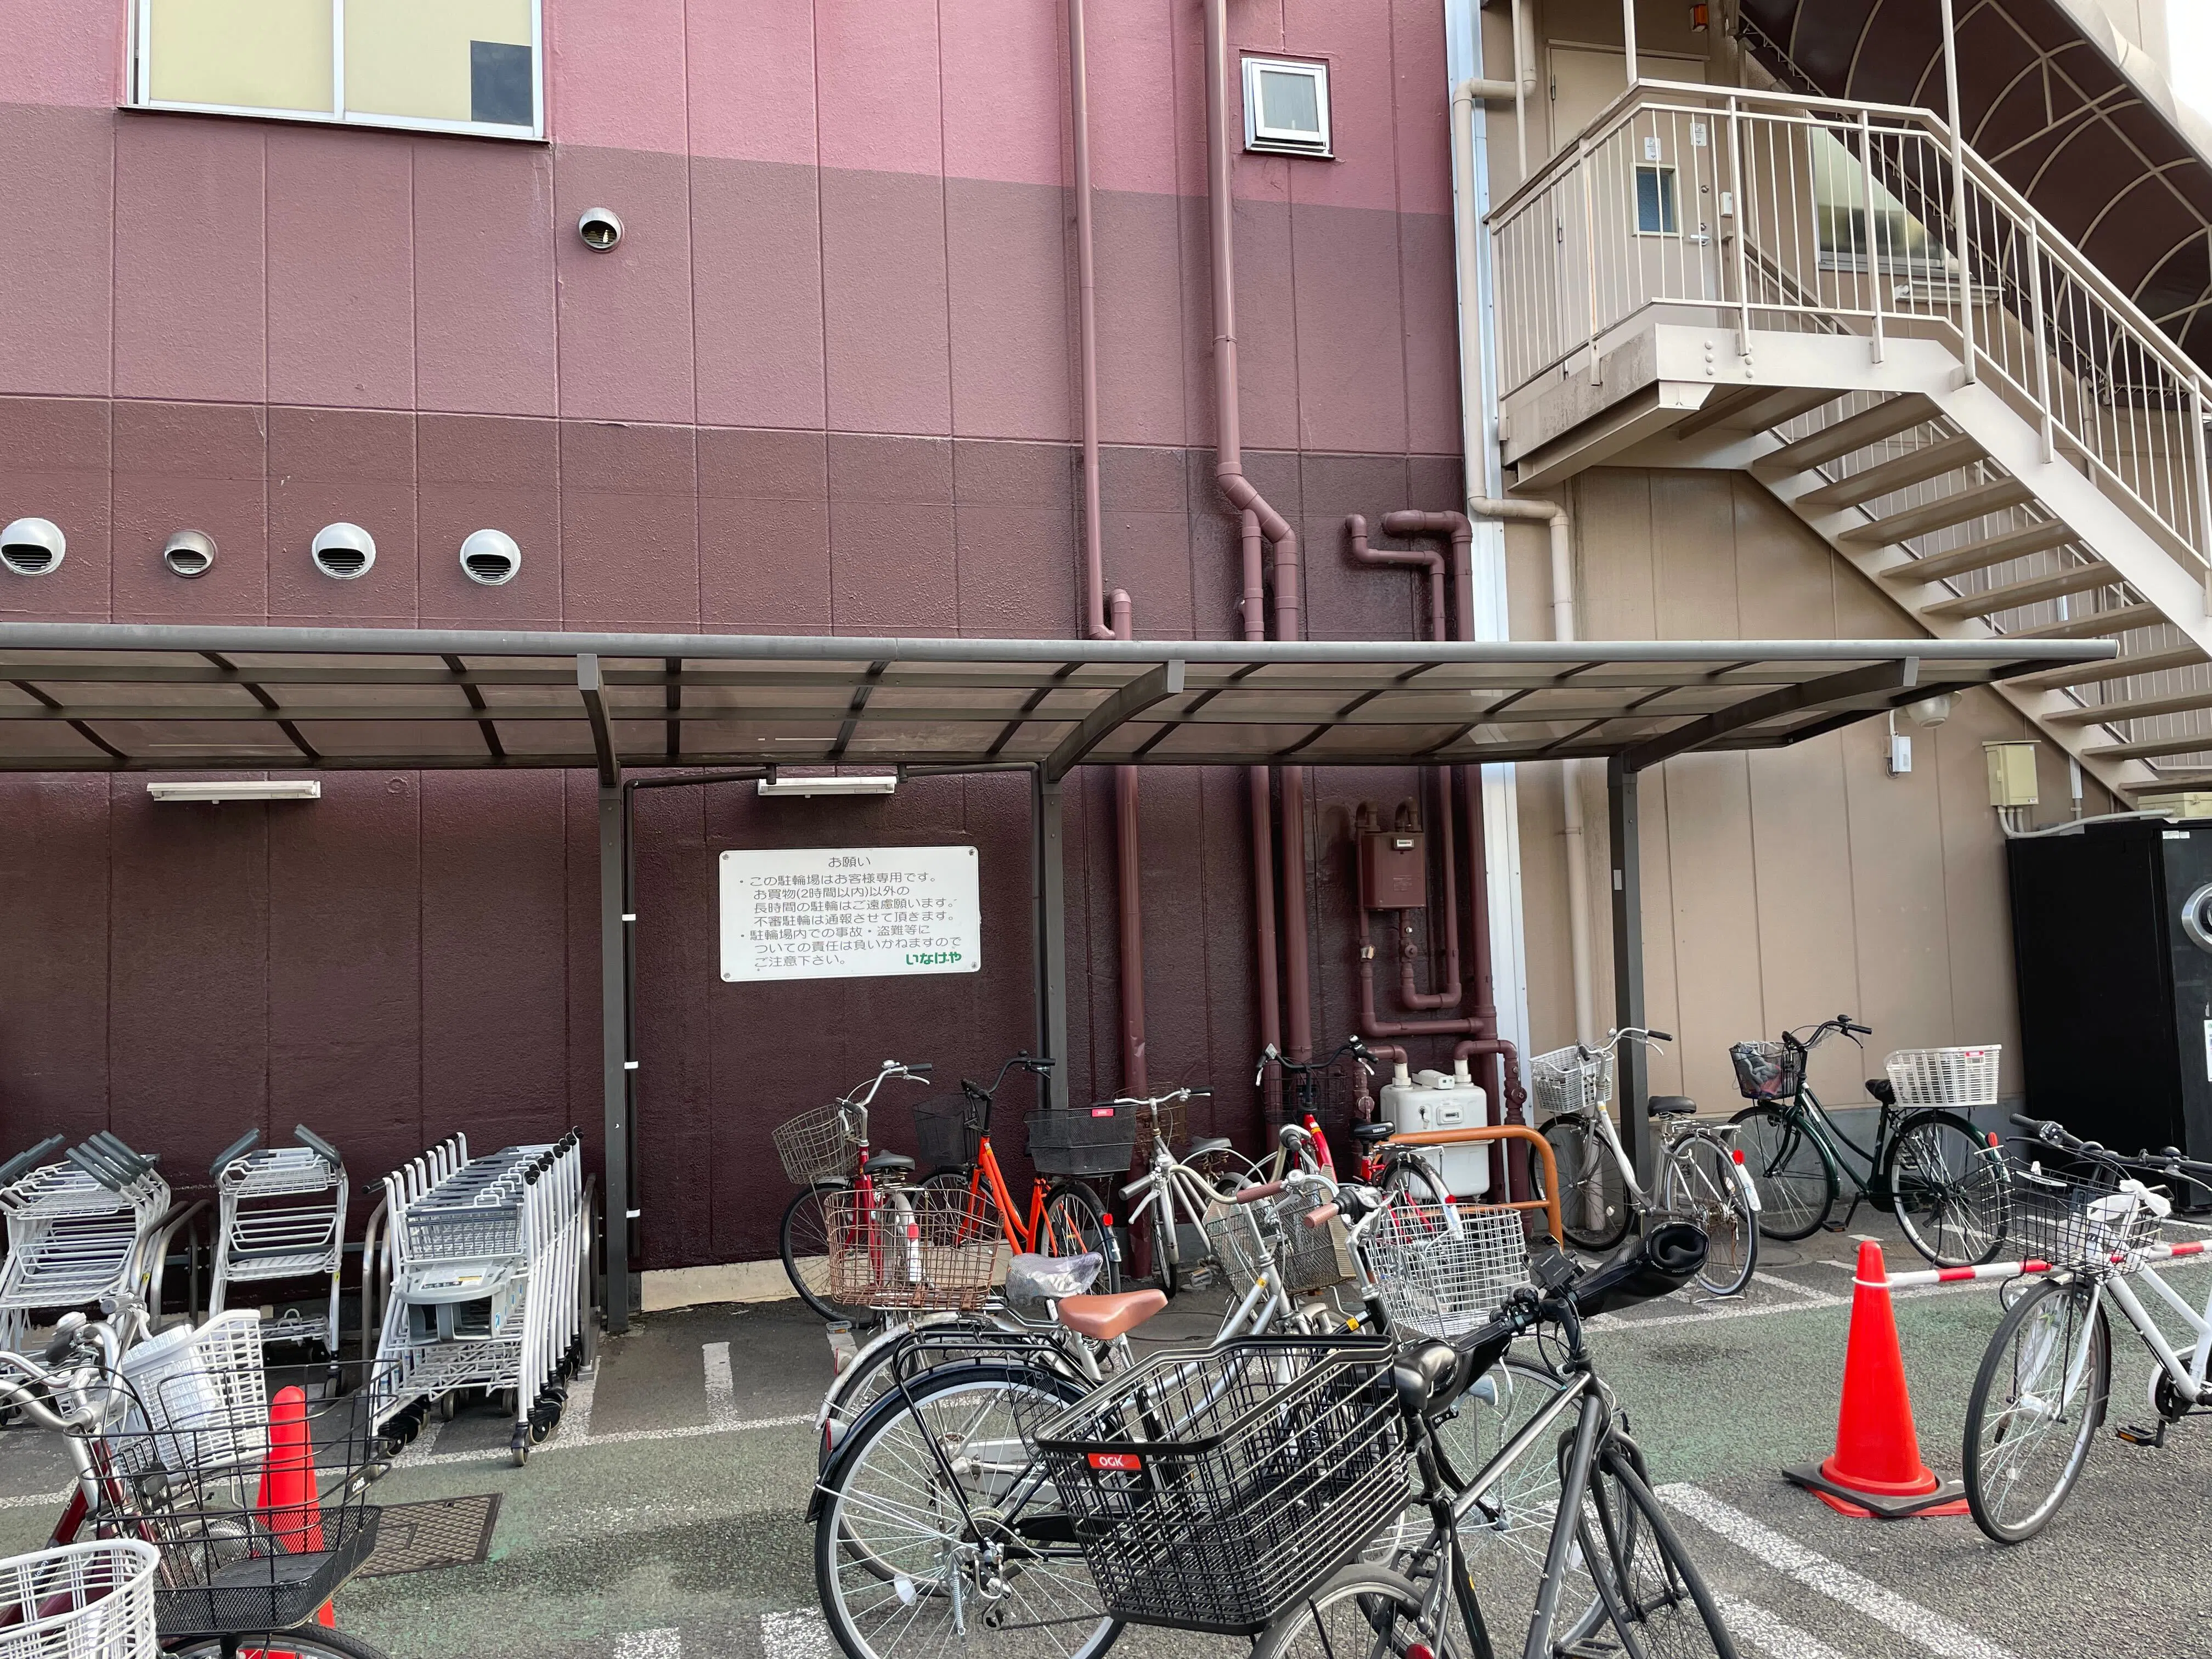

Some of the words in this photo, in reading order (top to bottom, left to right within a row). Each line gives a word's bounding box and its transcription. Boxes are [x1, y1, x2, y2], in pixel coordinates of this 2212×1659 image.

[828, 856, 871, 868] お願い
[754, 898, 953, 913] 長時間の駐輪はご遠慮願います。
[754, 910, 953, 927] 不審駐輪は通報させて頂きます。
[754, 936, 962, 953] ついての責任は負いかねますので
[754, 954, 845, 967] ご注意下さい。
[1099, 1454, 1125, 1467] OGK
